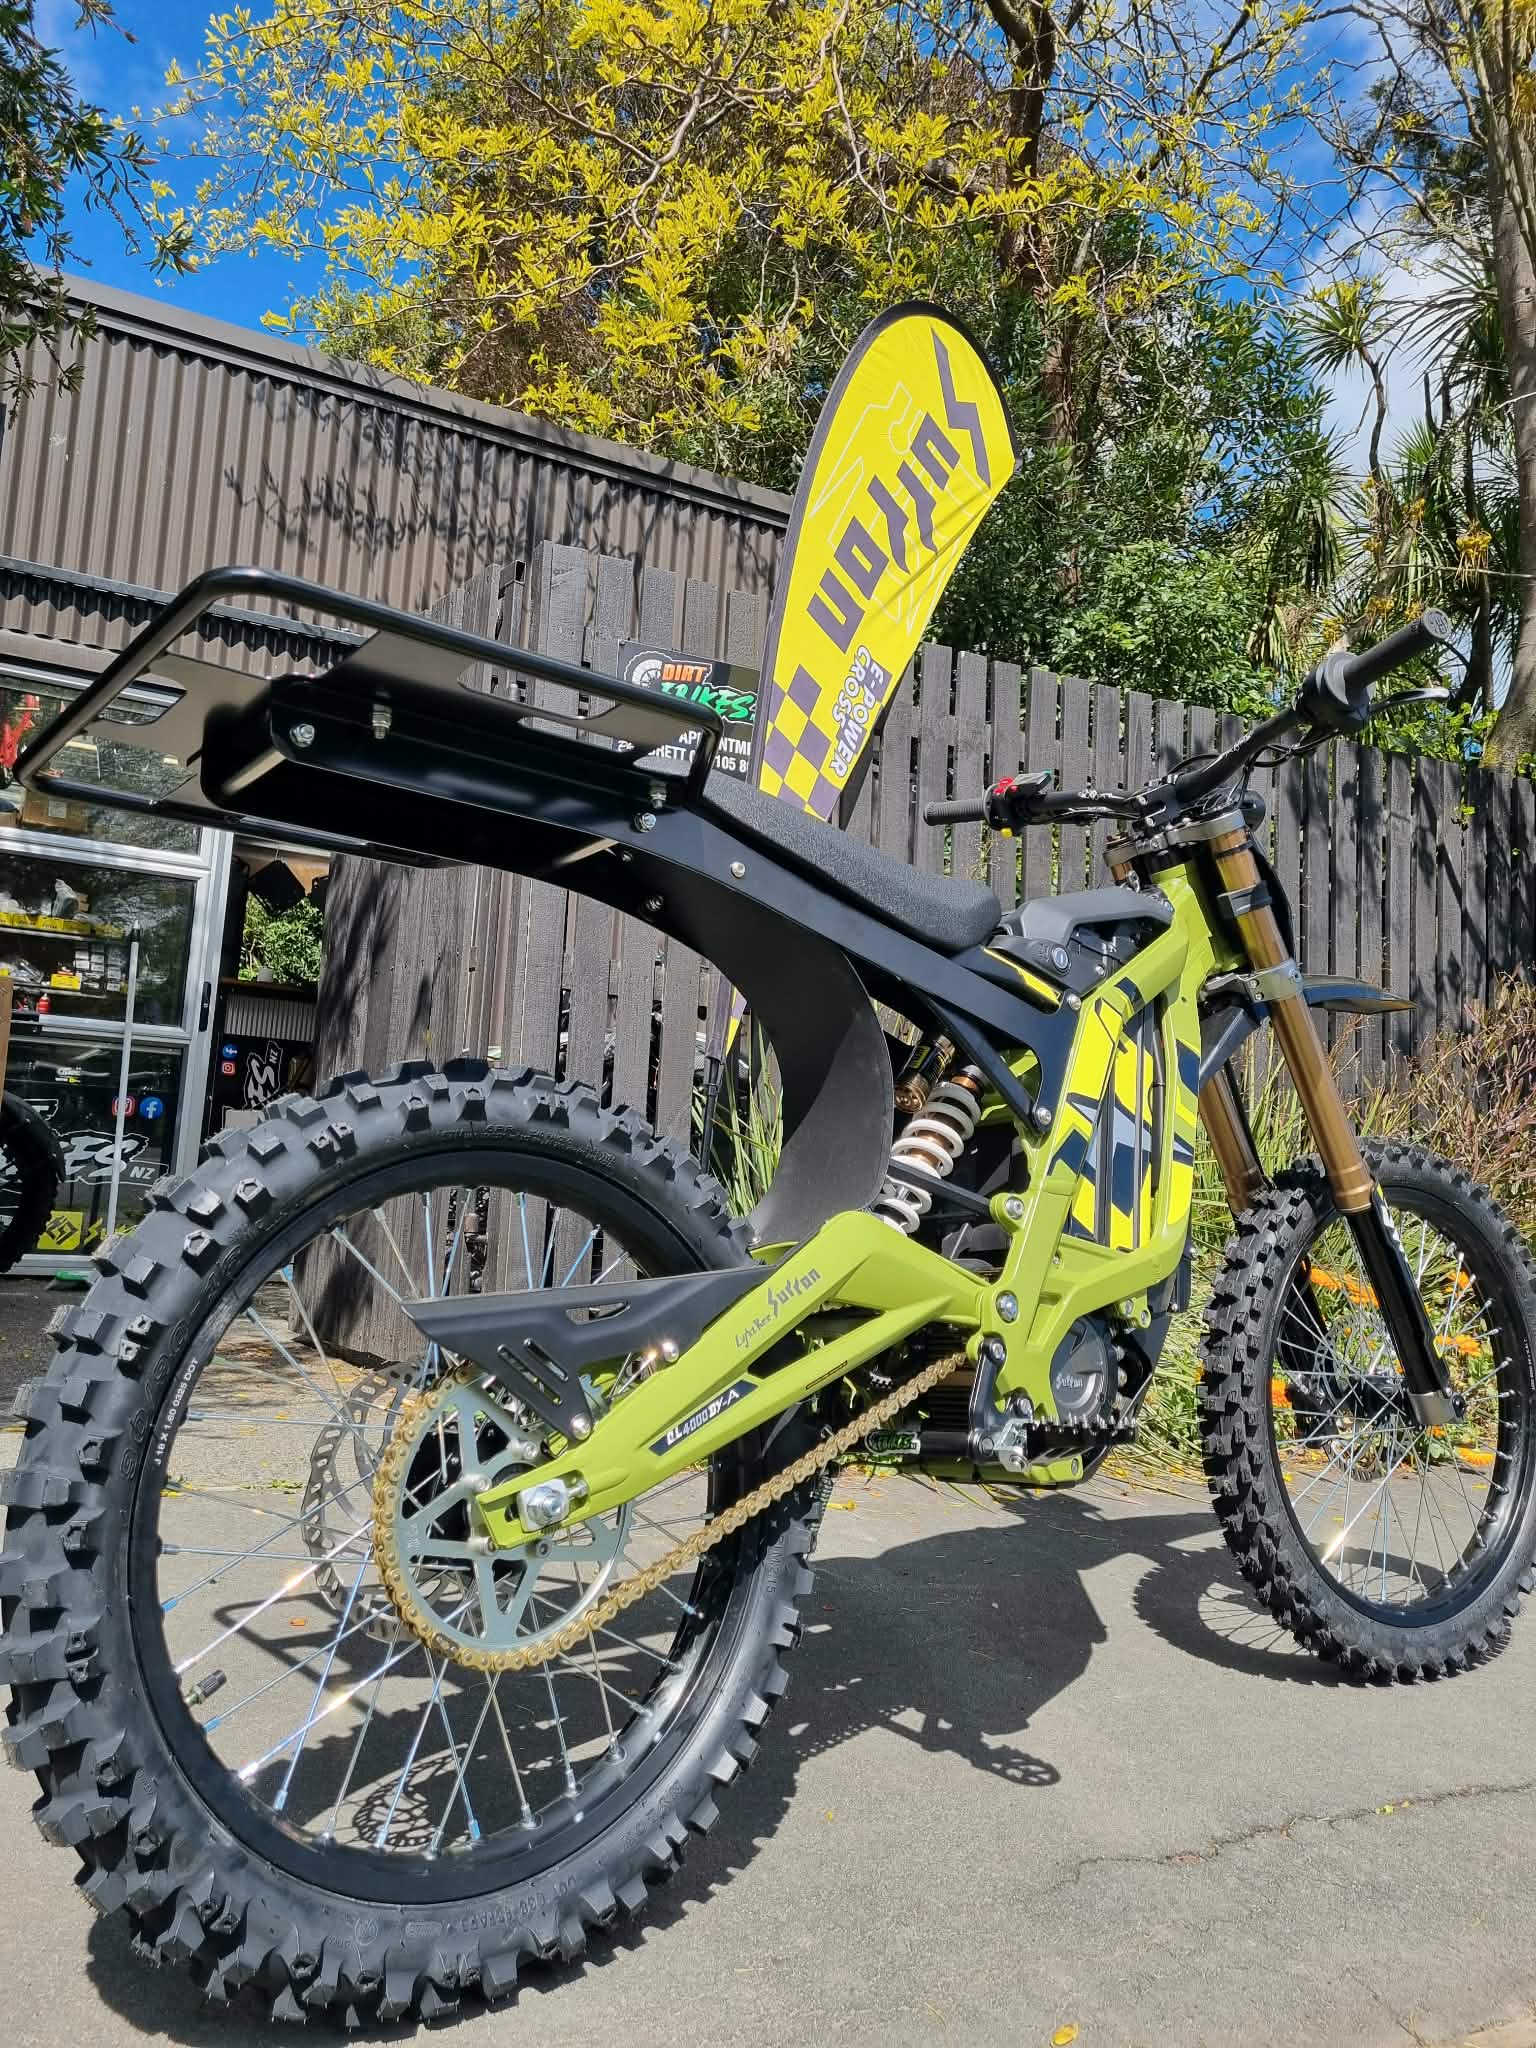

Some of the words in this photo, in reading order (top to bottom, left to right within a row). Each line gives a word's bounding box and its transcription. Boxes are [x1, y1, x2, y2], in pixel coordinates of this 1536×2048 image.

[661, 663, 708, 683] DIRT
[832, 645, 871, 728] CROSS
[829, 661, 884, 777] E-POWER
[269, 1048, 279, 1064] NZ
[129, 1166, 156, 1180] NZ
[184, 1358, 199, 1382] DOT
